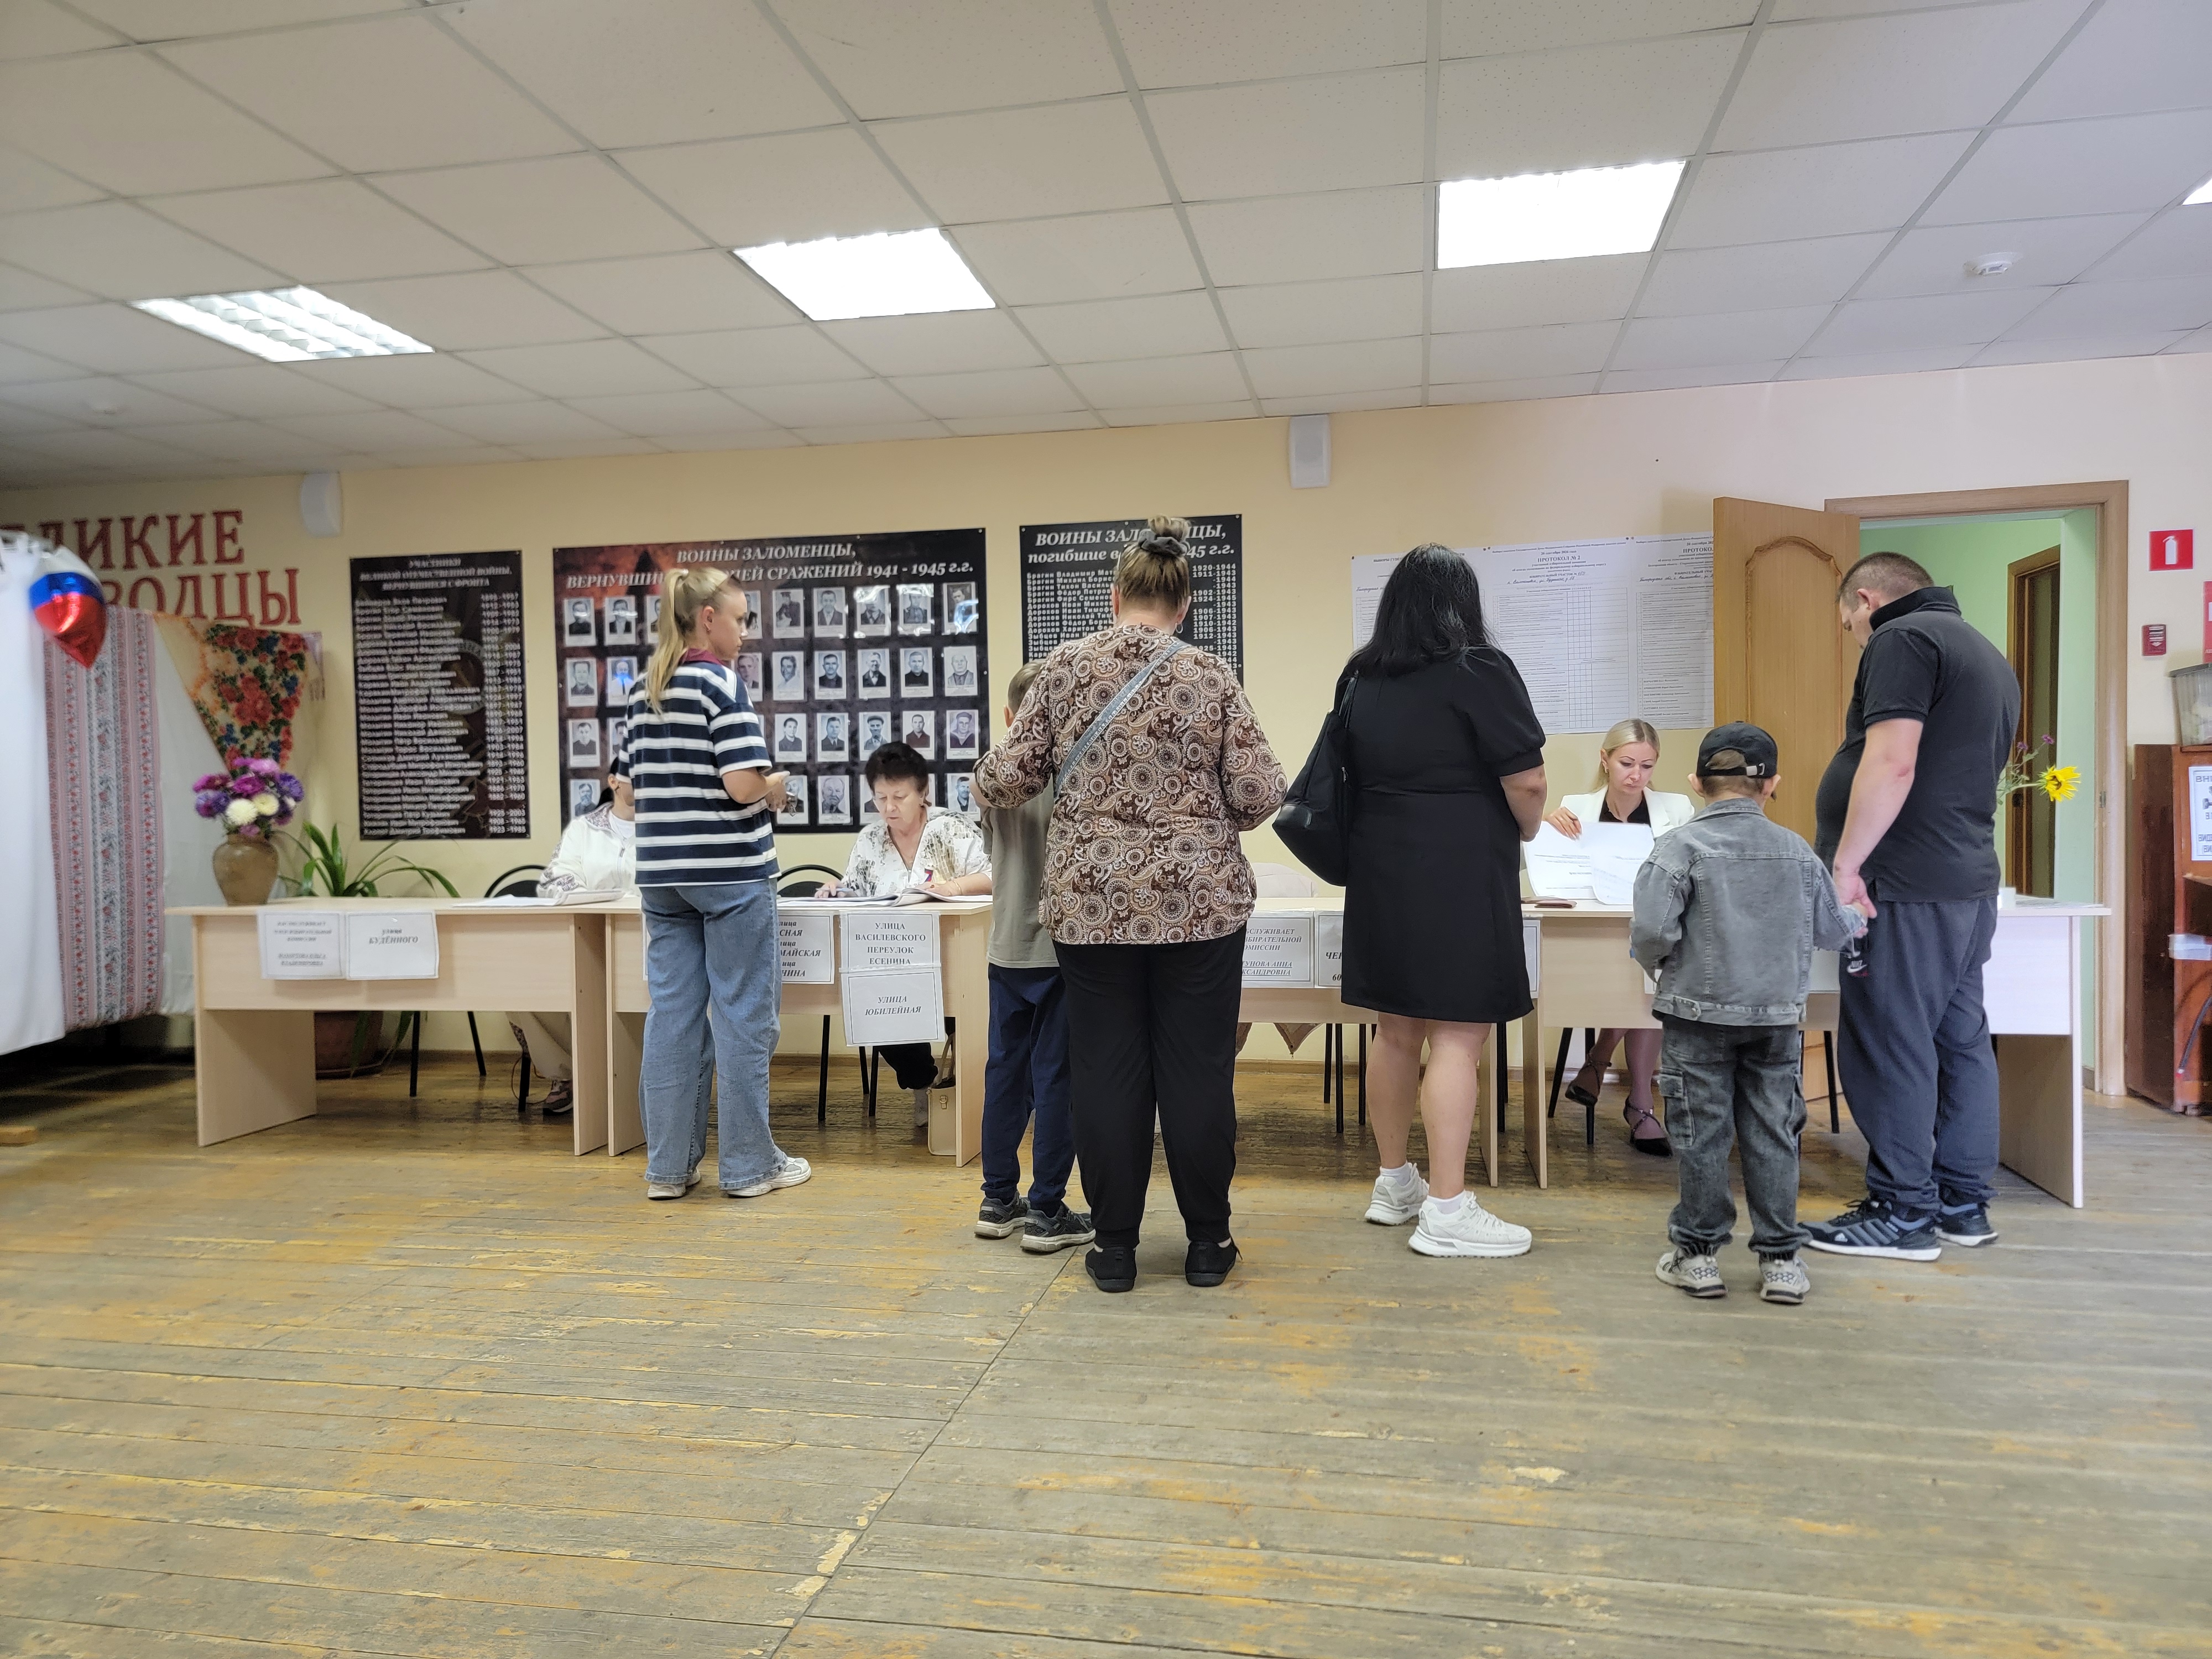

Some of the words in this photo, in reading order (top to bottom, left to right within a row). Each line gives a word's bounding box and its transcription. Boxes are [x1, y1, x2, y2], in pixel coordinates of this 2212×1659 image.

[1035, 530, 1103, 546] ВОИНЫ
[1105, 524, 1226, 543] ЗАЛЦЫ,
[676, 546, 739, 564] ВОИНЫ
[742, 543, 857, 561] ЗАЛОМЕНЦЫ,
[1027, 548, 1107, 564] погибшие
[1186, 545, 1207, 559] 45
[1209, 544, 1234, 555] г.г.
[768, 561, 864, 581] СРАЖЕНИЙ
[867, 565, 898, 578] 1941
[911, 562, 946, 576] 1945
[949, 562, 973, 573] г.г.
[875, 922, 905, 931] УЛИЦА
[855, 933, 926, 942] ВАСИЛЕВСКОГО
[878, 995, 907, 1004] УЛИЦА
[865, 1005, 921, 1016] ЮБИЛЕЙНАЯ
